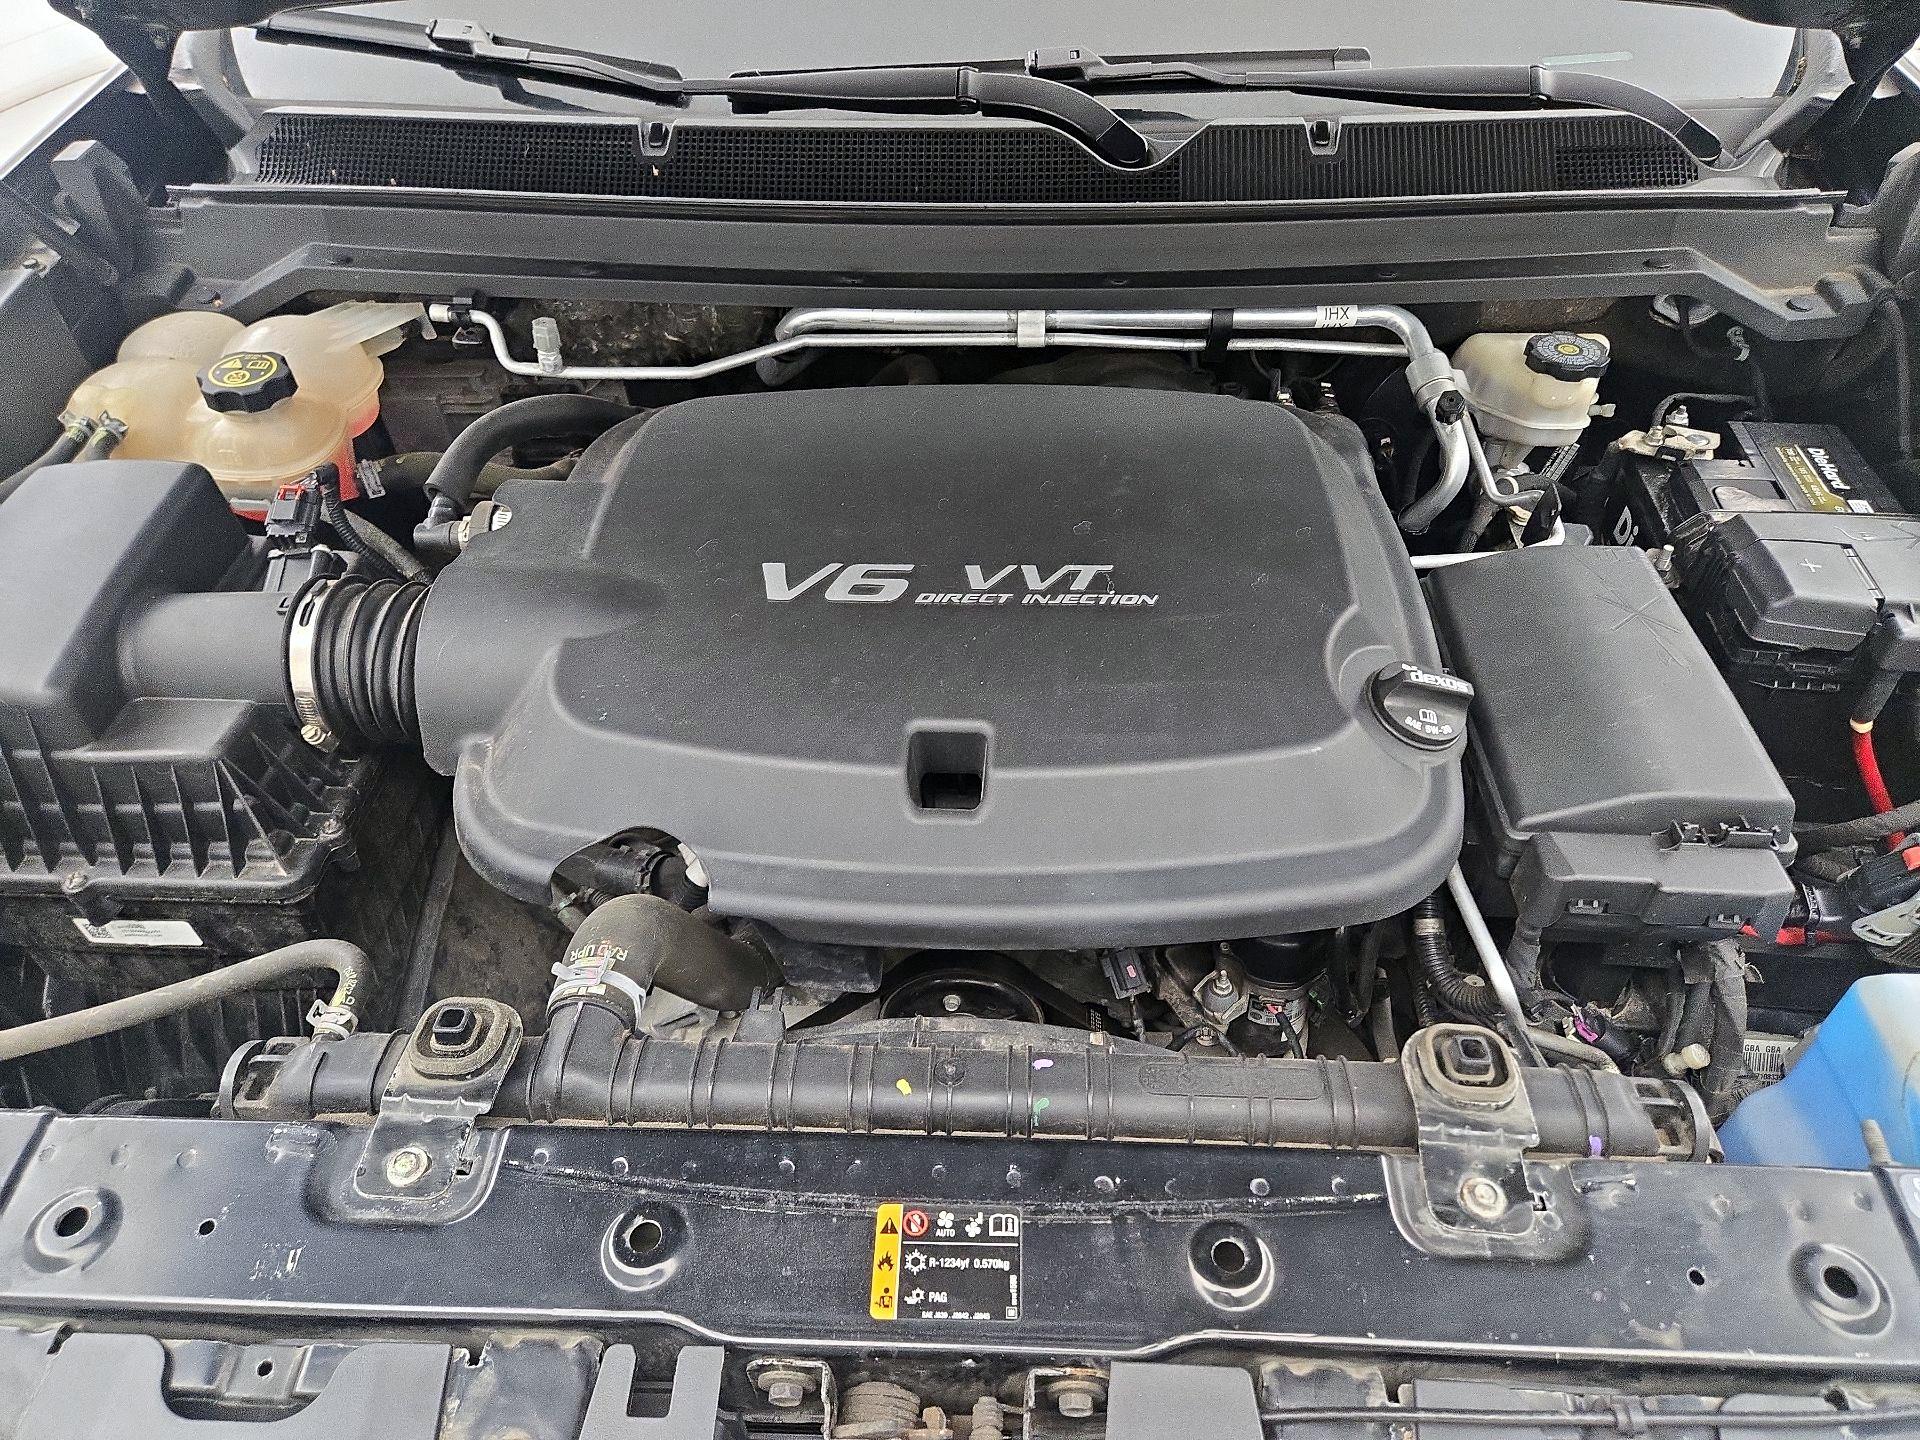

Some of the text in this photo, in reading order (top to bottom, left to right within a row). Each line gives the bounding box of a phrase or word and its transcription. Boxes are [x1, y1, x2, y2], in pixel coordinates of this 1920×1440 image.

[1807, 447, 1851, 490] DieHard
[762, 563, 1114, 602] V6 VVT
[914, 593, 1159, 605] DIRECT INJECTION
[1410, 669, 1468, 693] dexos
[1405, 716, 1422, 730] SAE
[935, 1228, 956, 1237] AUTO
[928, 1257, 1010, 1271] R-1234yf 0.570kg
[928, 1291, 948, 1303] PAG
